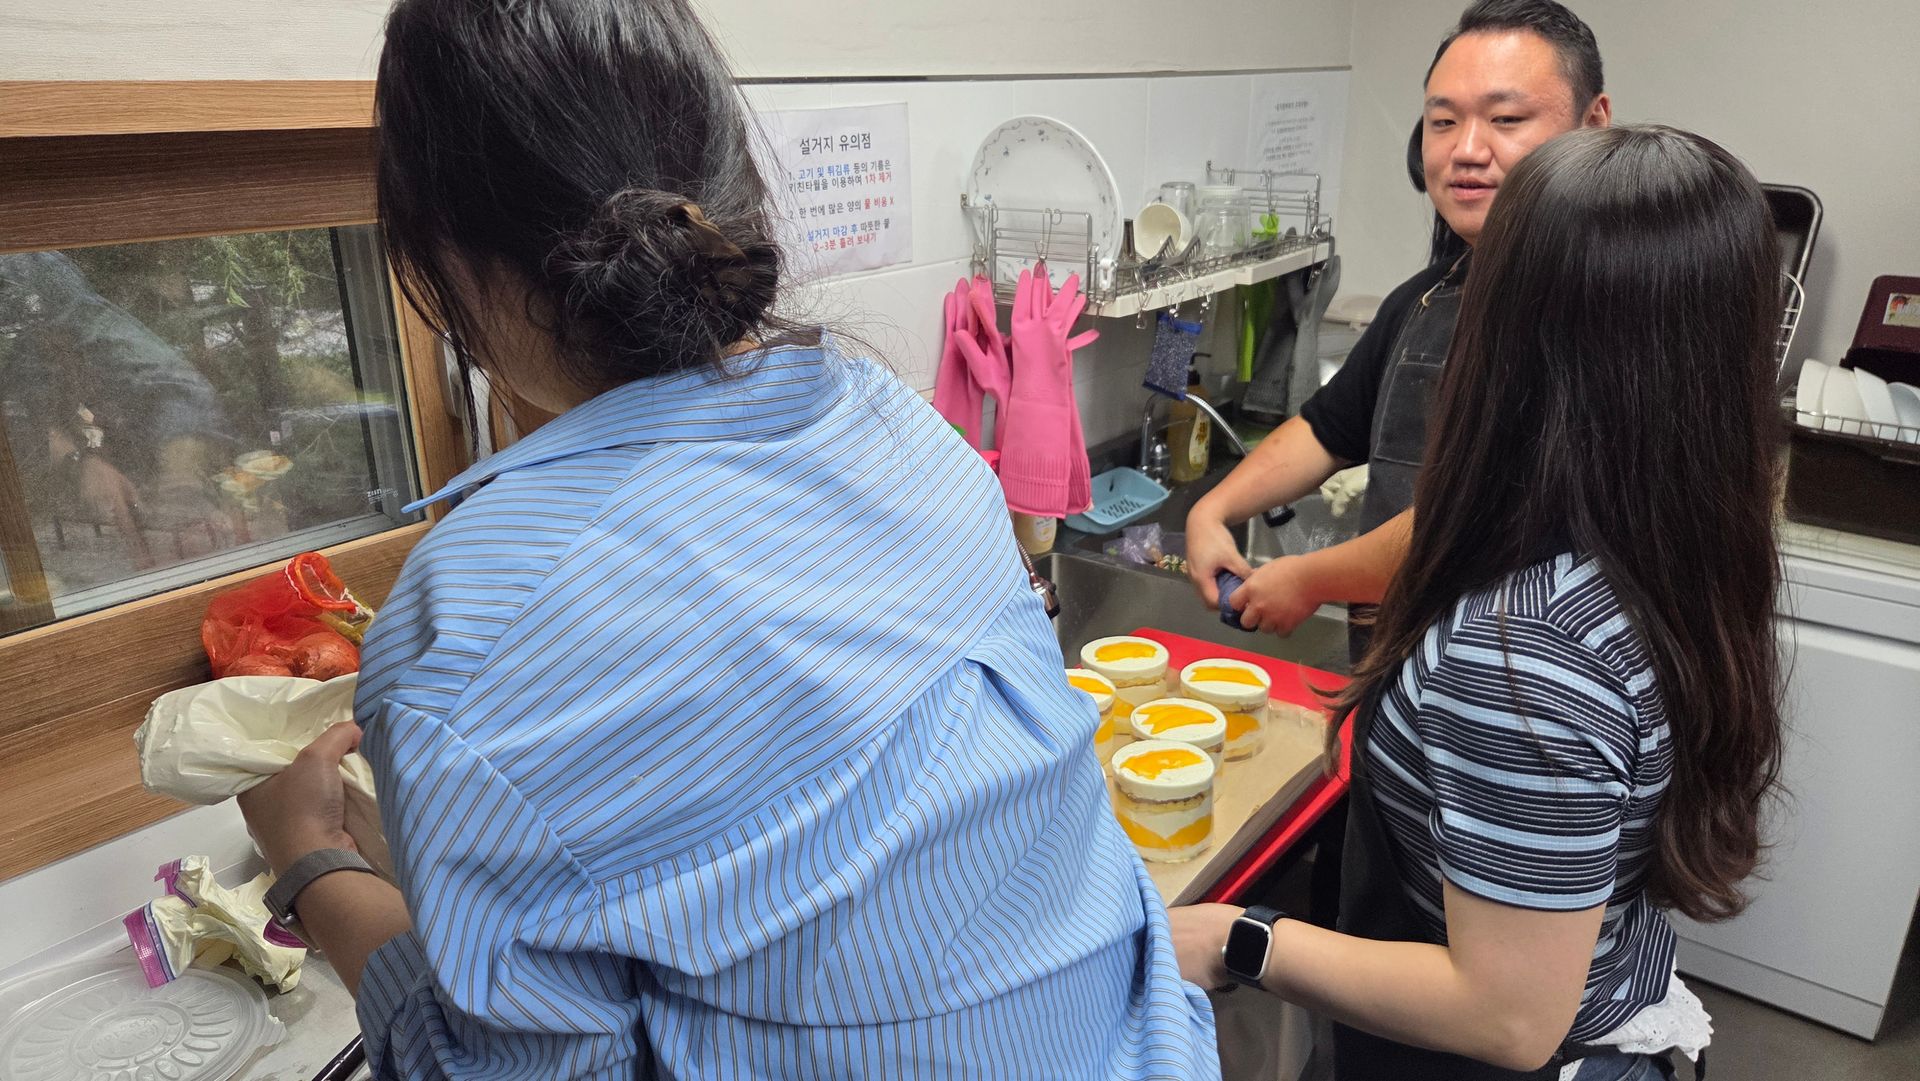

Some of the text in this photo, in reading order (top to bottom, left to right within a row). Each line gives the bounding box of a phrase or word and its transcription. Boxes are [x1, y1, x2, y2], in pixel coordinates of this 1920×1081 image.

[800, 132, 871, 155] 설거지 유의점
[799, 168, 814, 180] 고기
[817, 166, 825, 178] 및
[827, 163, 850, 177] 튀김류
[853, 161, 868, 174] 등의
[870, 159, 892, 172] 기름은
[788, 171, 892, 194] 키친타월을 이용하여 1차 제거
[799, 207, 807, 219] 한
[810, 205, 826, 217] 번에
[828, 202, 844, 215] 많은
[847, 199, 862, 213] 양의
[864, 198, 871, 210] 물
[807, 227, 830, 242] 설거지
[832, 225, 848, 238] 마감
[850, 223, 858, 235] 후
[860, 219, 881, 233] 따뜻한
[883, 218, 890, 230] 물
[839, 236, 855, 249] 흘려
[857, 232, 877, 246] 보내기
